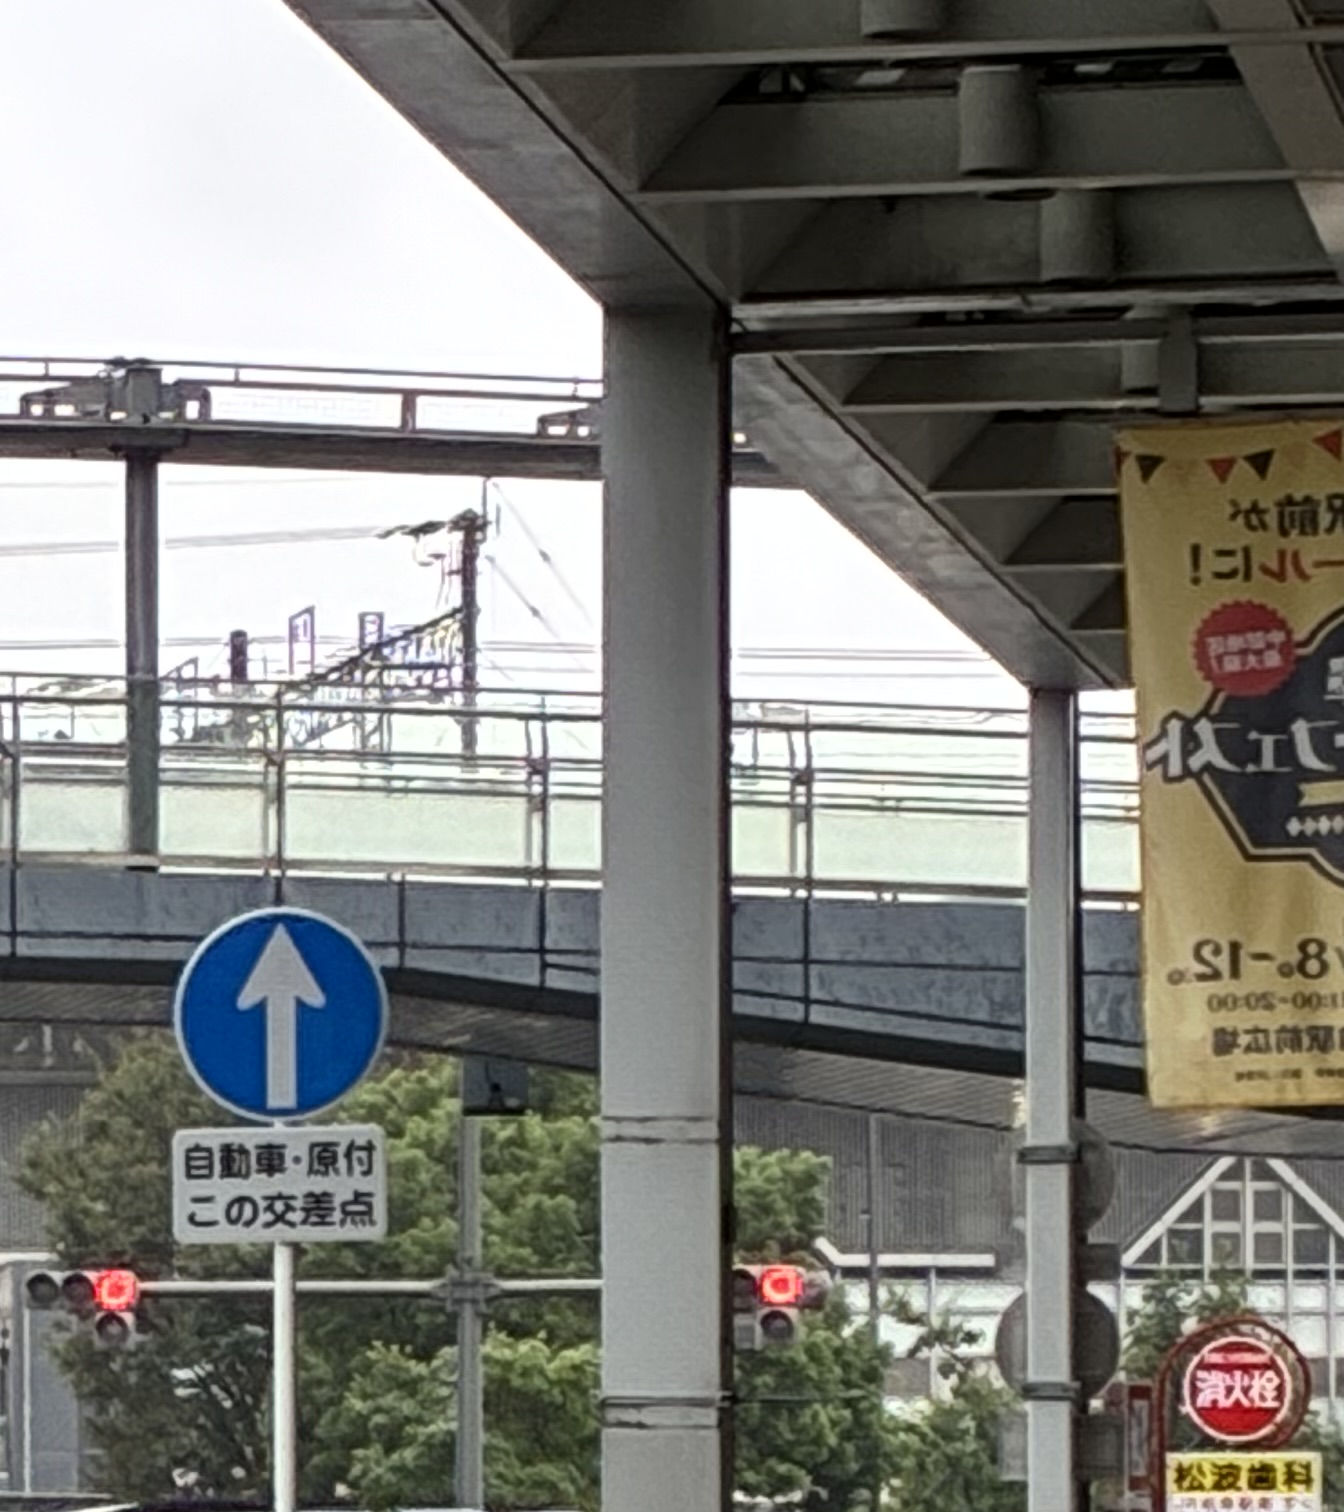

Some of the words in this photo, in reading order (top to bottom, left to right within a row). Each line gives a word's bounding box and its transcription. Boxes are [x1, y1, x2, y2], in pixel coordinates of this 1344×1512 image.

[184, 1140, 376, 1181] 自動車・原付
[186, 1190, 378, 1229] この交差点
[1195, 1369, 1282, 1409] 消火栓
[1173, 1459, 1314, 1492] 松波歯科
